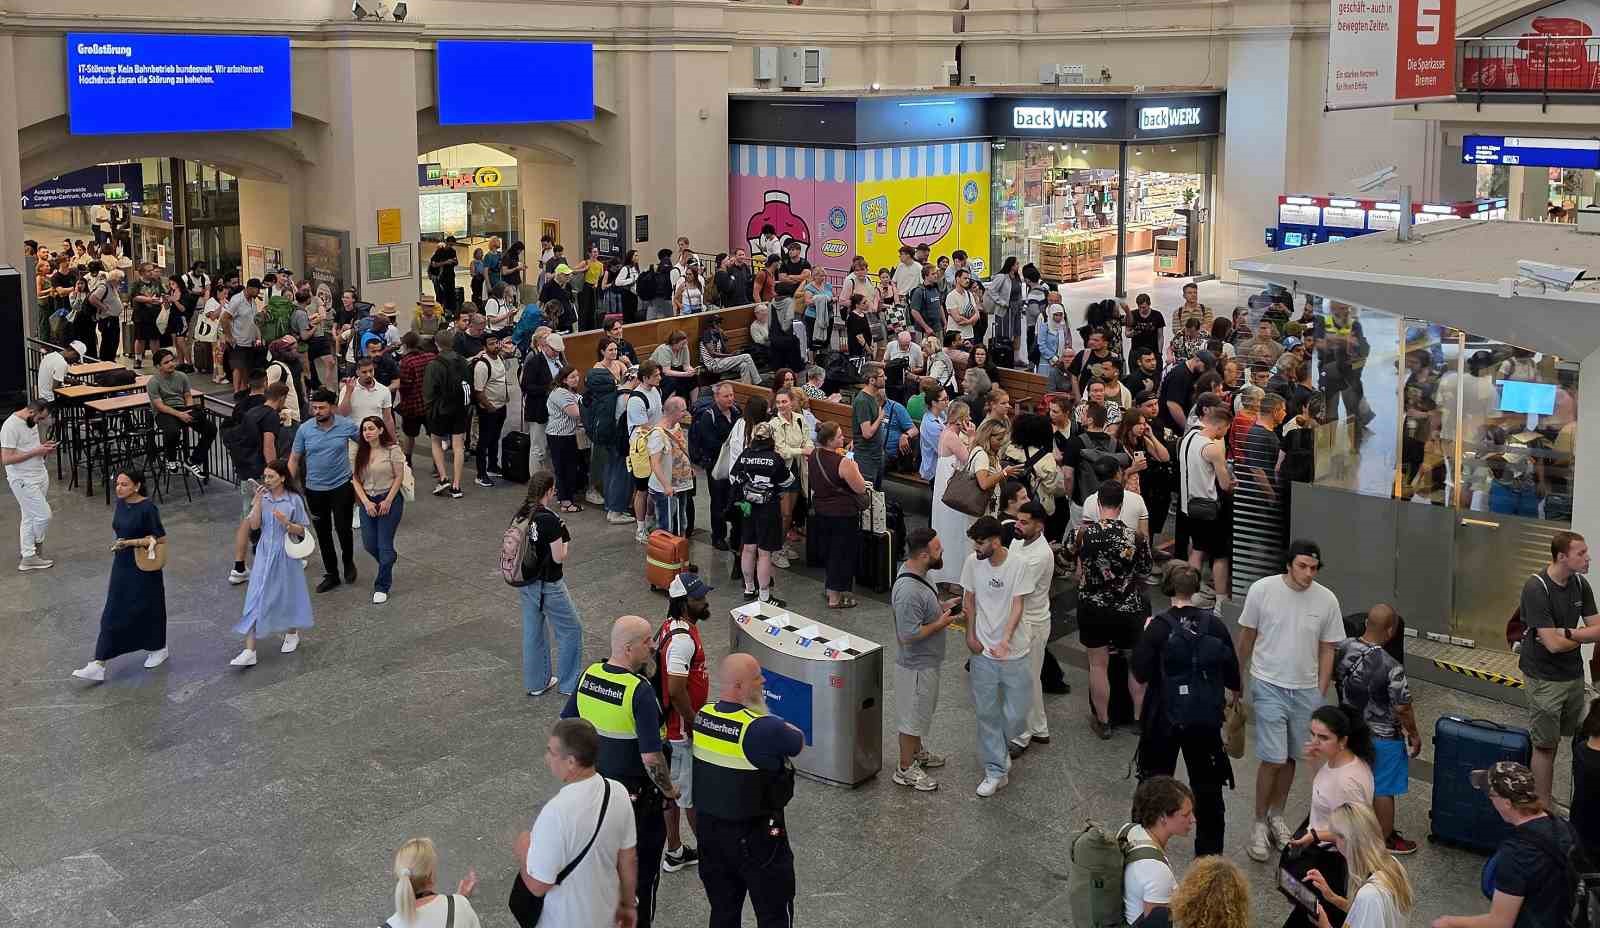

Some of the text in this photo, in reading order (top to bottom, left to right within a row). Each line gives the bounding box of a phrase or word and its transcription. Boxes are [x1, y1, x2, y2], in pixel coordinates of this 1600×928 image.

[1371, 3, 1385, 14] auch
[1386, 2, 1392, 13] in
[1337, 19, 1369, 34] bewegten
[77, 43, 132, 57] Großstörung
[78, 64, 265, 75] IT-Störung: Kein Bahnbetrieb bundesweit. Wir arbeiten mit
[1407, 57, 1446, 72] Die Sparkasse
[78, 75, 116, 85] Hochdruck
[116, 76, 137, 84] daran
[137, 76, 148, 84] die
[148, 75, 175, 86] Störung
[184, 75, 215, 84] beheben.
[1415, 75, 1437, 86] Bremen
[1016, 110, 1108, 129] backWERK
[1143, 107, 1200, 127] backWERK
[590, 211, 618, 230] a&o
[902, 212, 950, 238] HOLY
[589, 681, 623, 700] Sicherheit
[702, 718, 740, 736] Sicherheit
